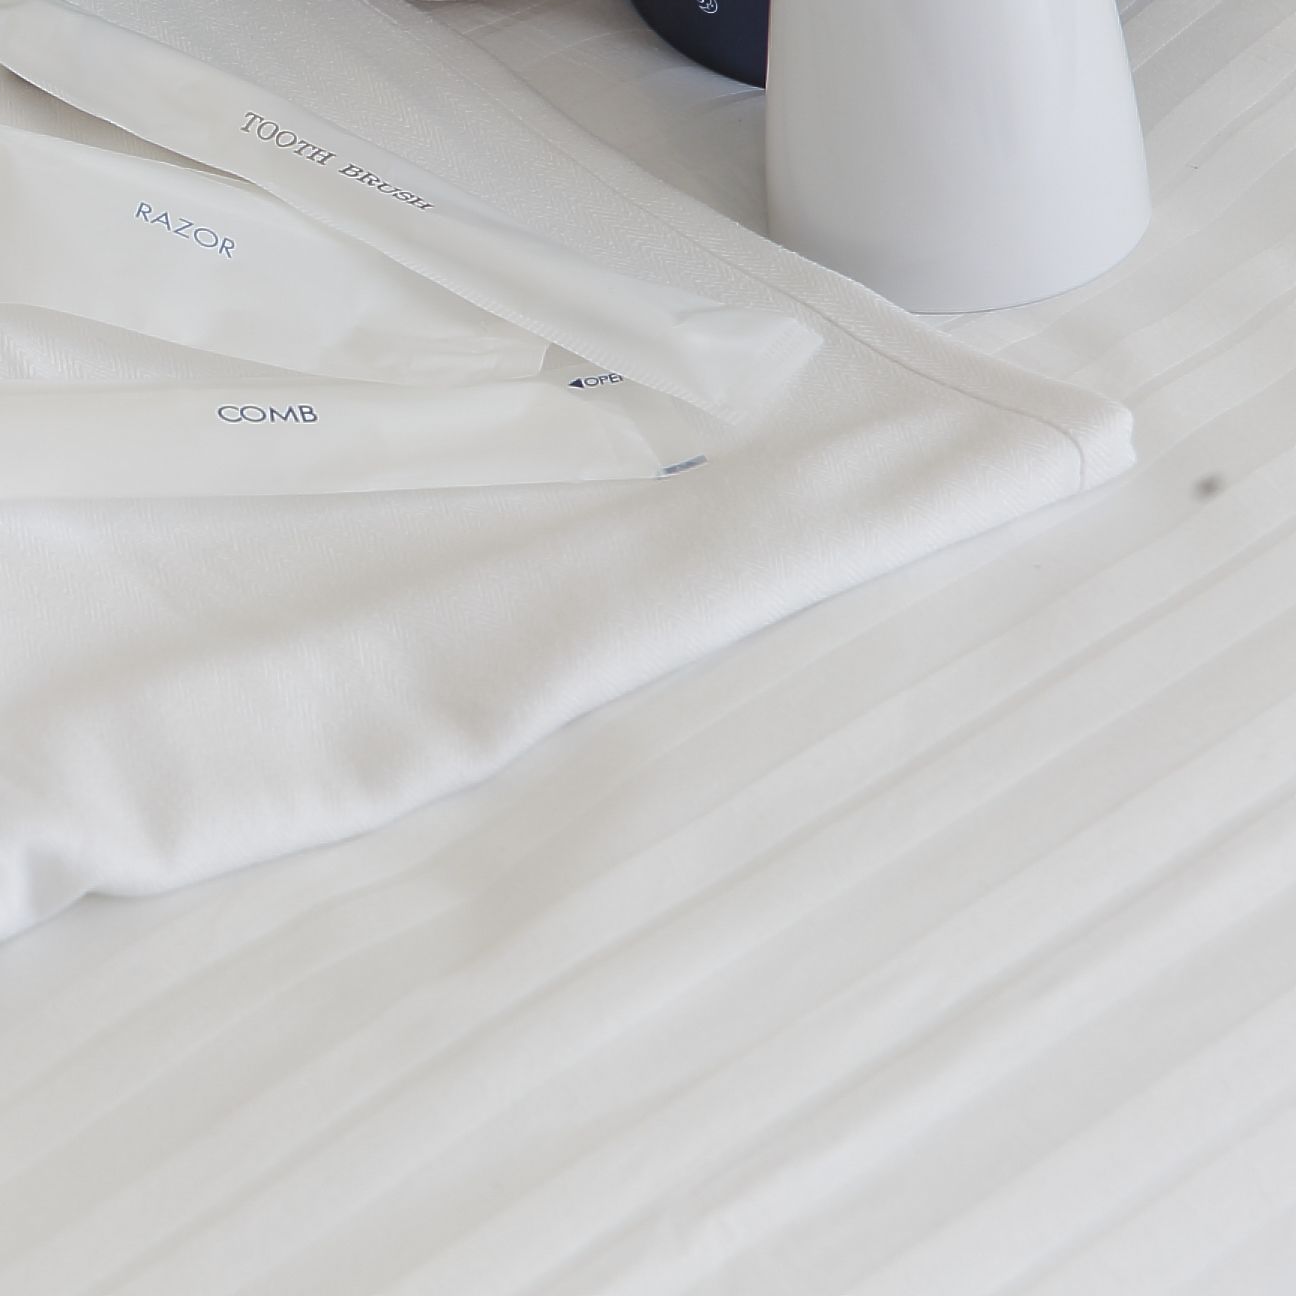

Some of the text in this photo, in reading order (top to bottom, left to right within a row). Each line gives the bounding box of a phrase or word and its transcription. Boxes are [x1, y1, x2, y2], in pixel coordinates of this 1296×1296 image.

[240, 111, 434, 211] TOOTH BRUSH
[135, 201, 236, 259] RAZOR
[217, 404, 319, 424] COMB
